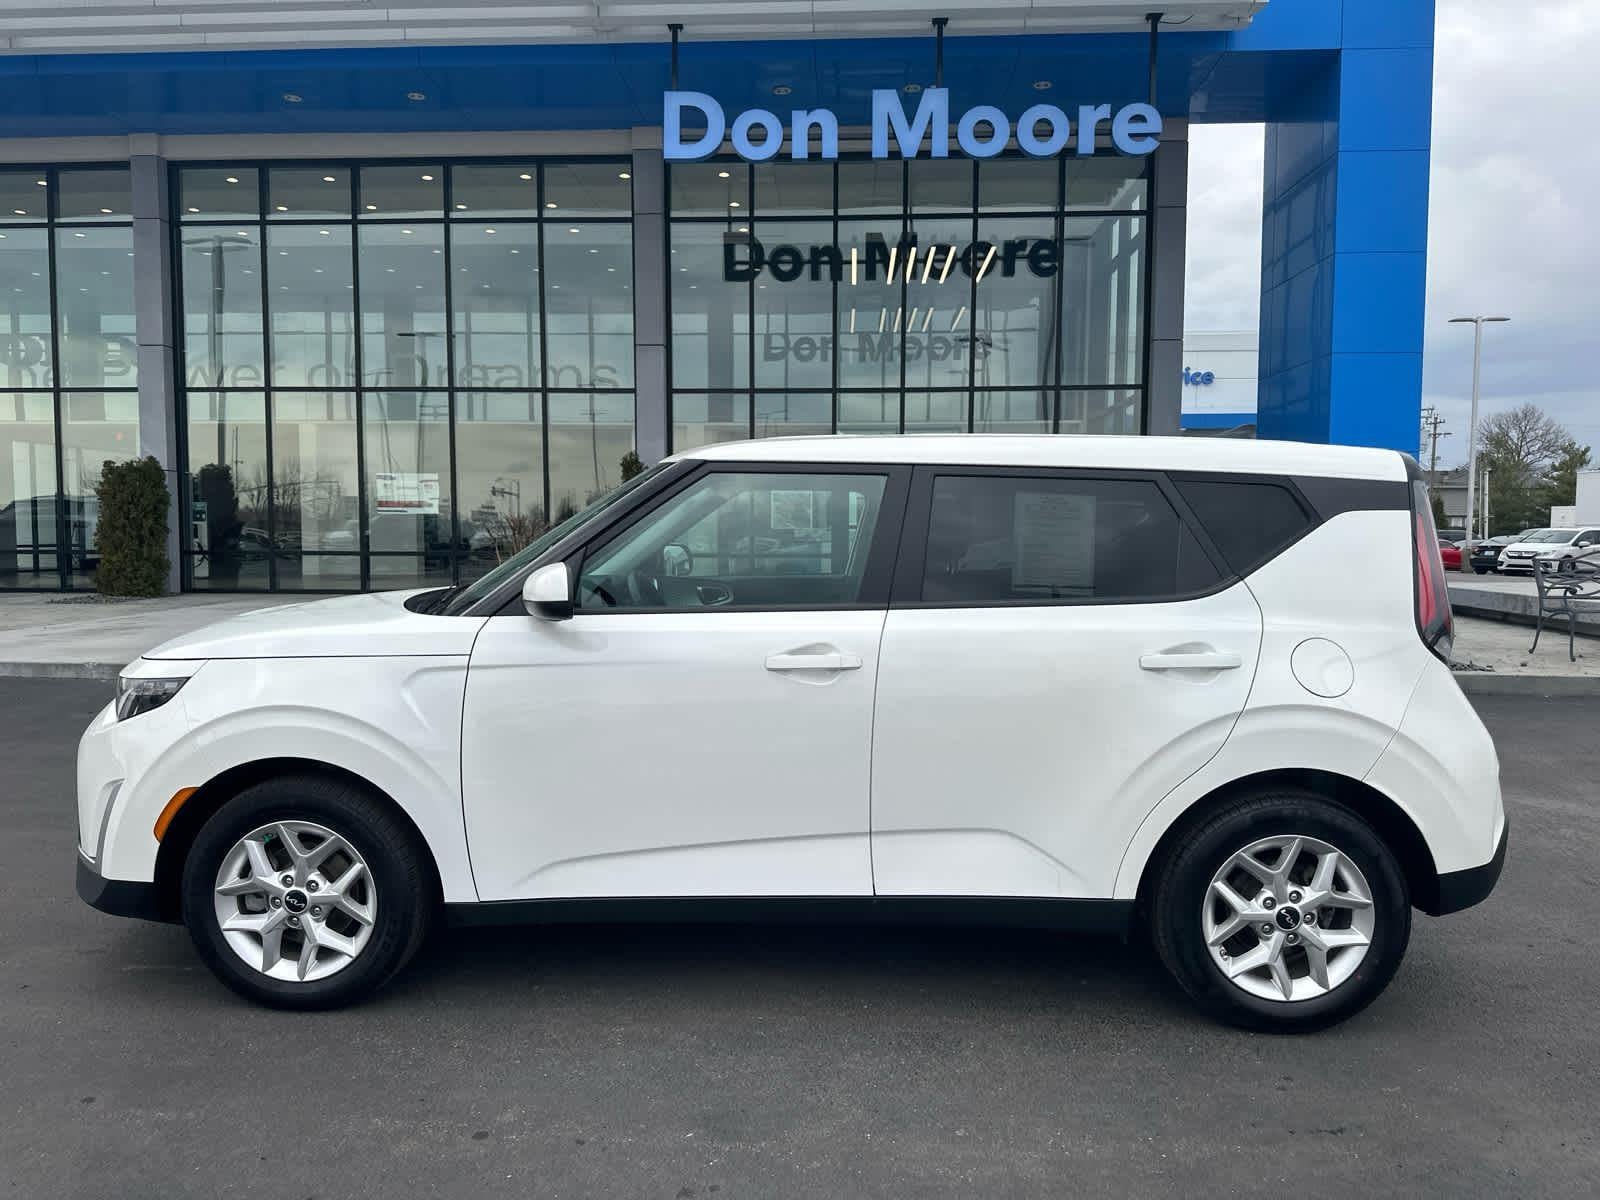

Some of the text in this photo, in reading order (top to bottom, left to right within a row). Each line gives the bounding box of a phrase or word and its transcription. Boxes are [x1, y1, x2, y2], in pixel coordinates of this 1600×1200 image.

[664, 87, 1163, 162] Don Moore
[723, 231, 1059, 282] Don Moore
